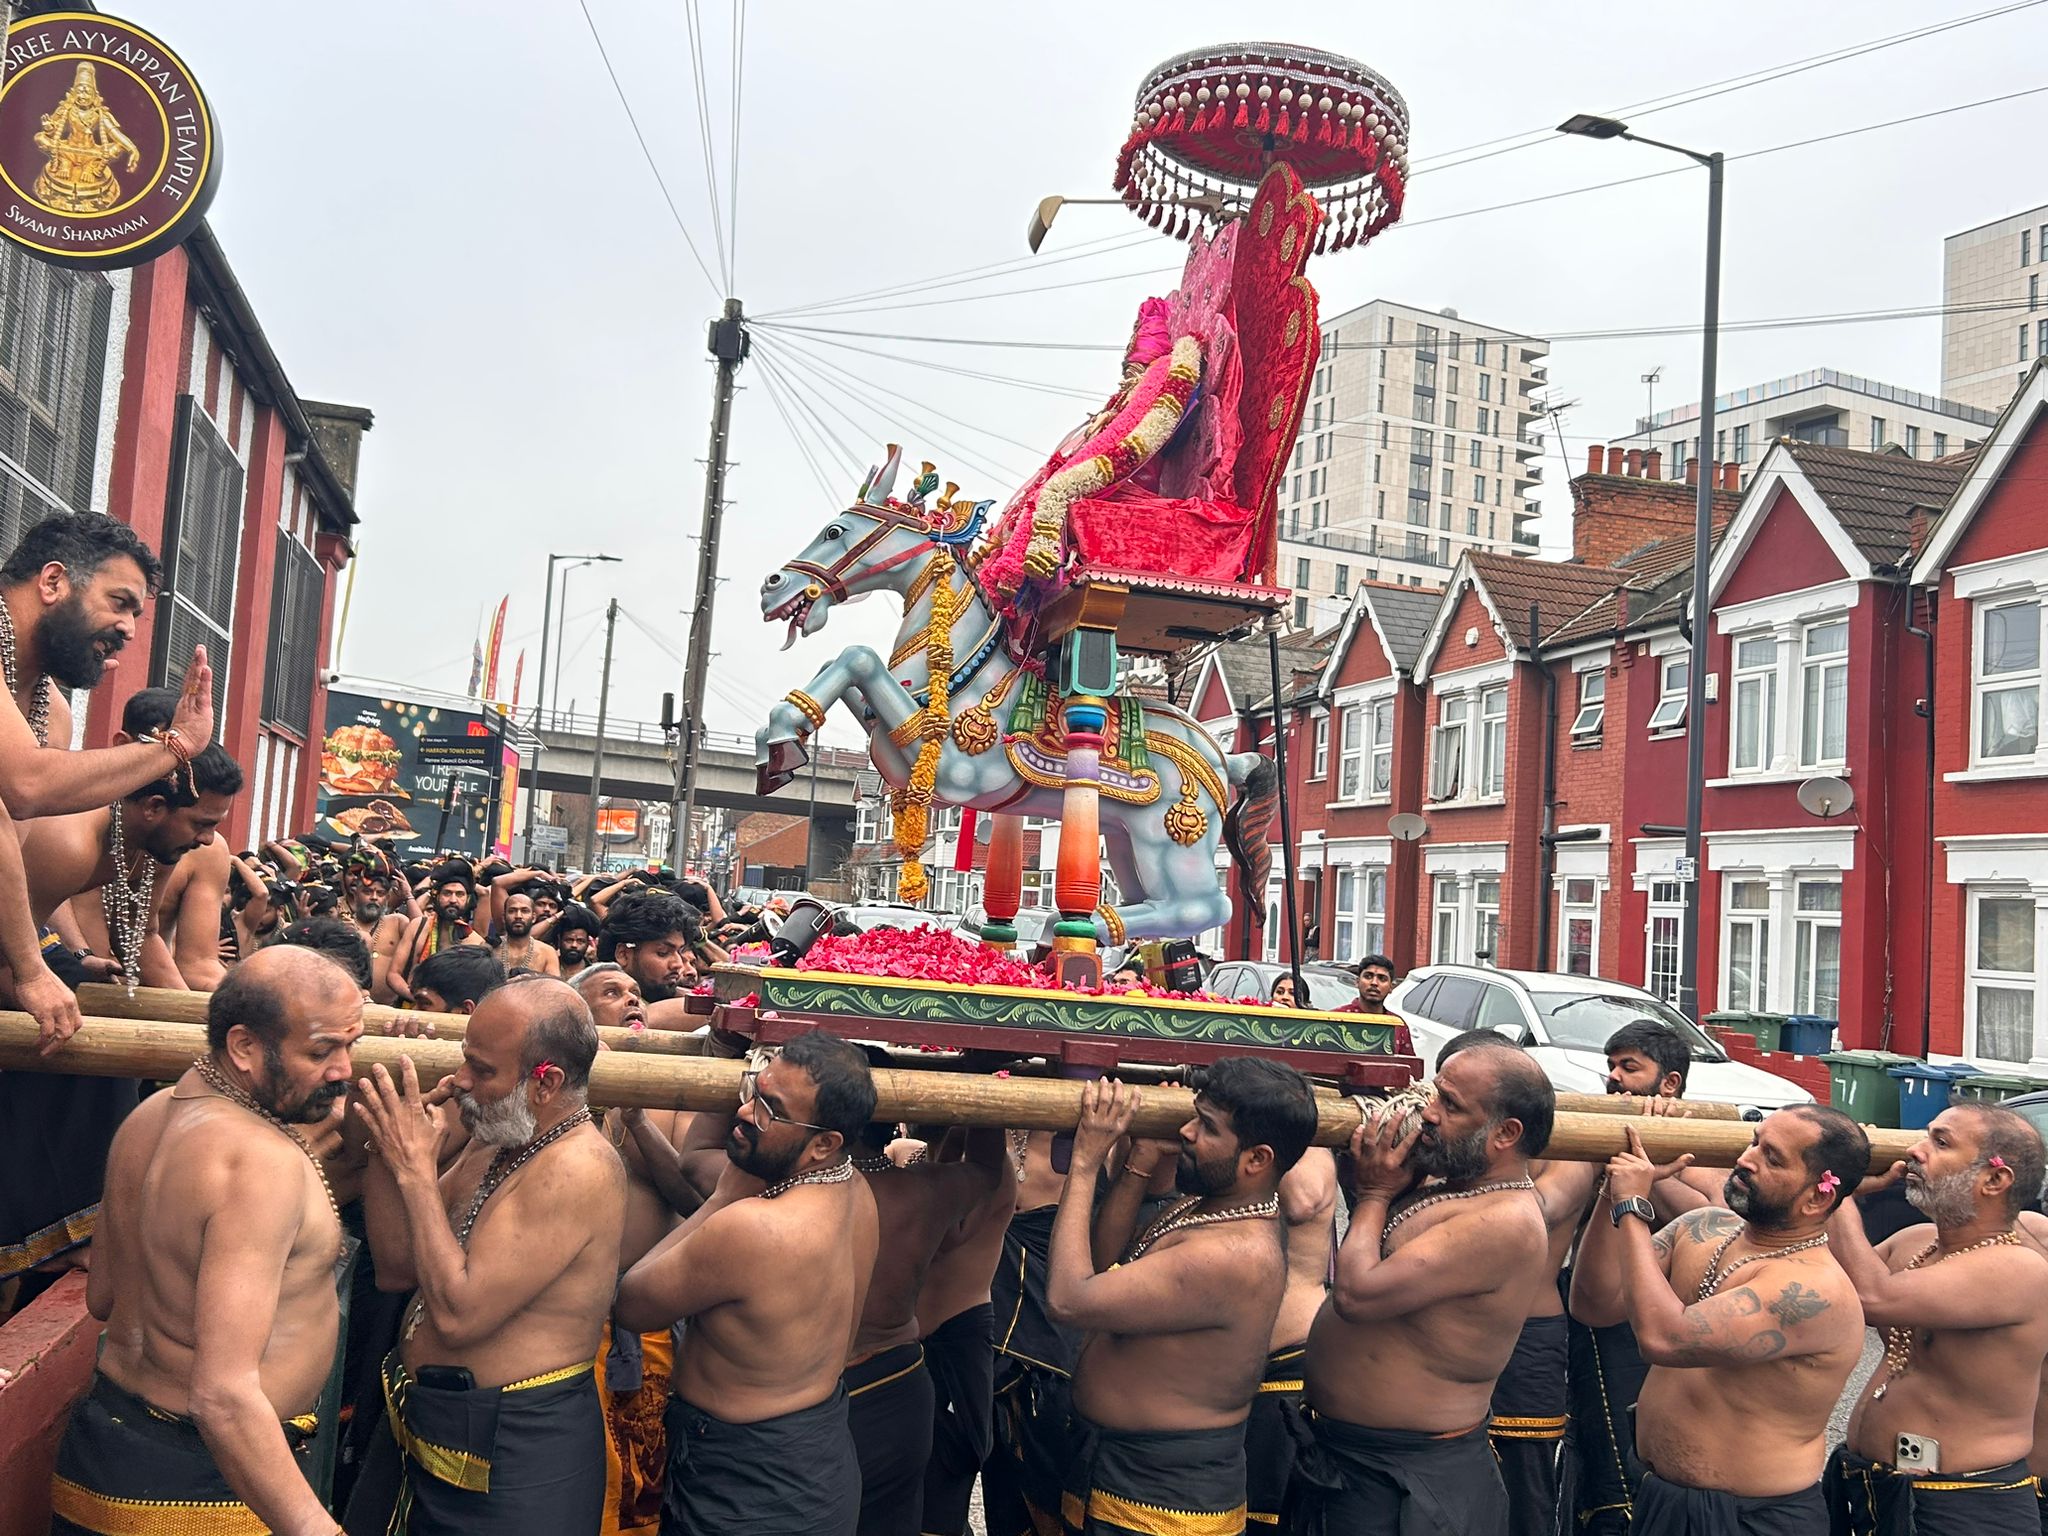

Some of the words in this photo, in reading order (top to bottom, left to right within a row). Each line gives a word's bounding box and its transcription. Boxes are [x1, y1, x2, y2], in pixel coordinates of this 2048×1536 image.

[5, 33, 55, 71] SREE
[62, 30, 186, 104] AYYAPPAN
[162, 108, 198, 201] TEMPLE
[5, 205, 58, 238] SWAMI
[62, 215, 149, 242] SHARANAM
[415, 775, 479, 793] YOURELF
[1835, 1077, 1857, 1105] 71
[1904, 1077, 1928, 1096] 71
